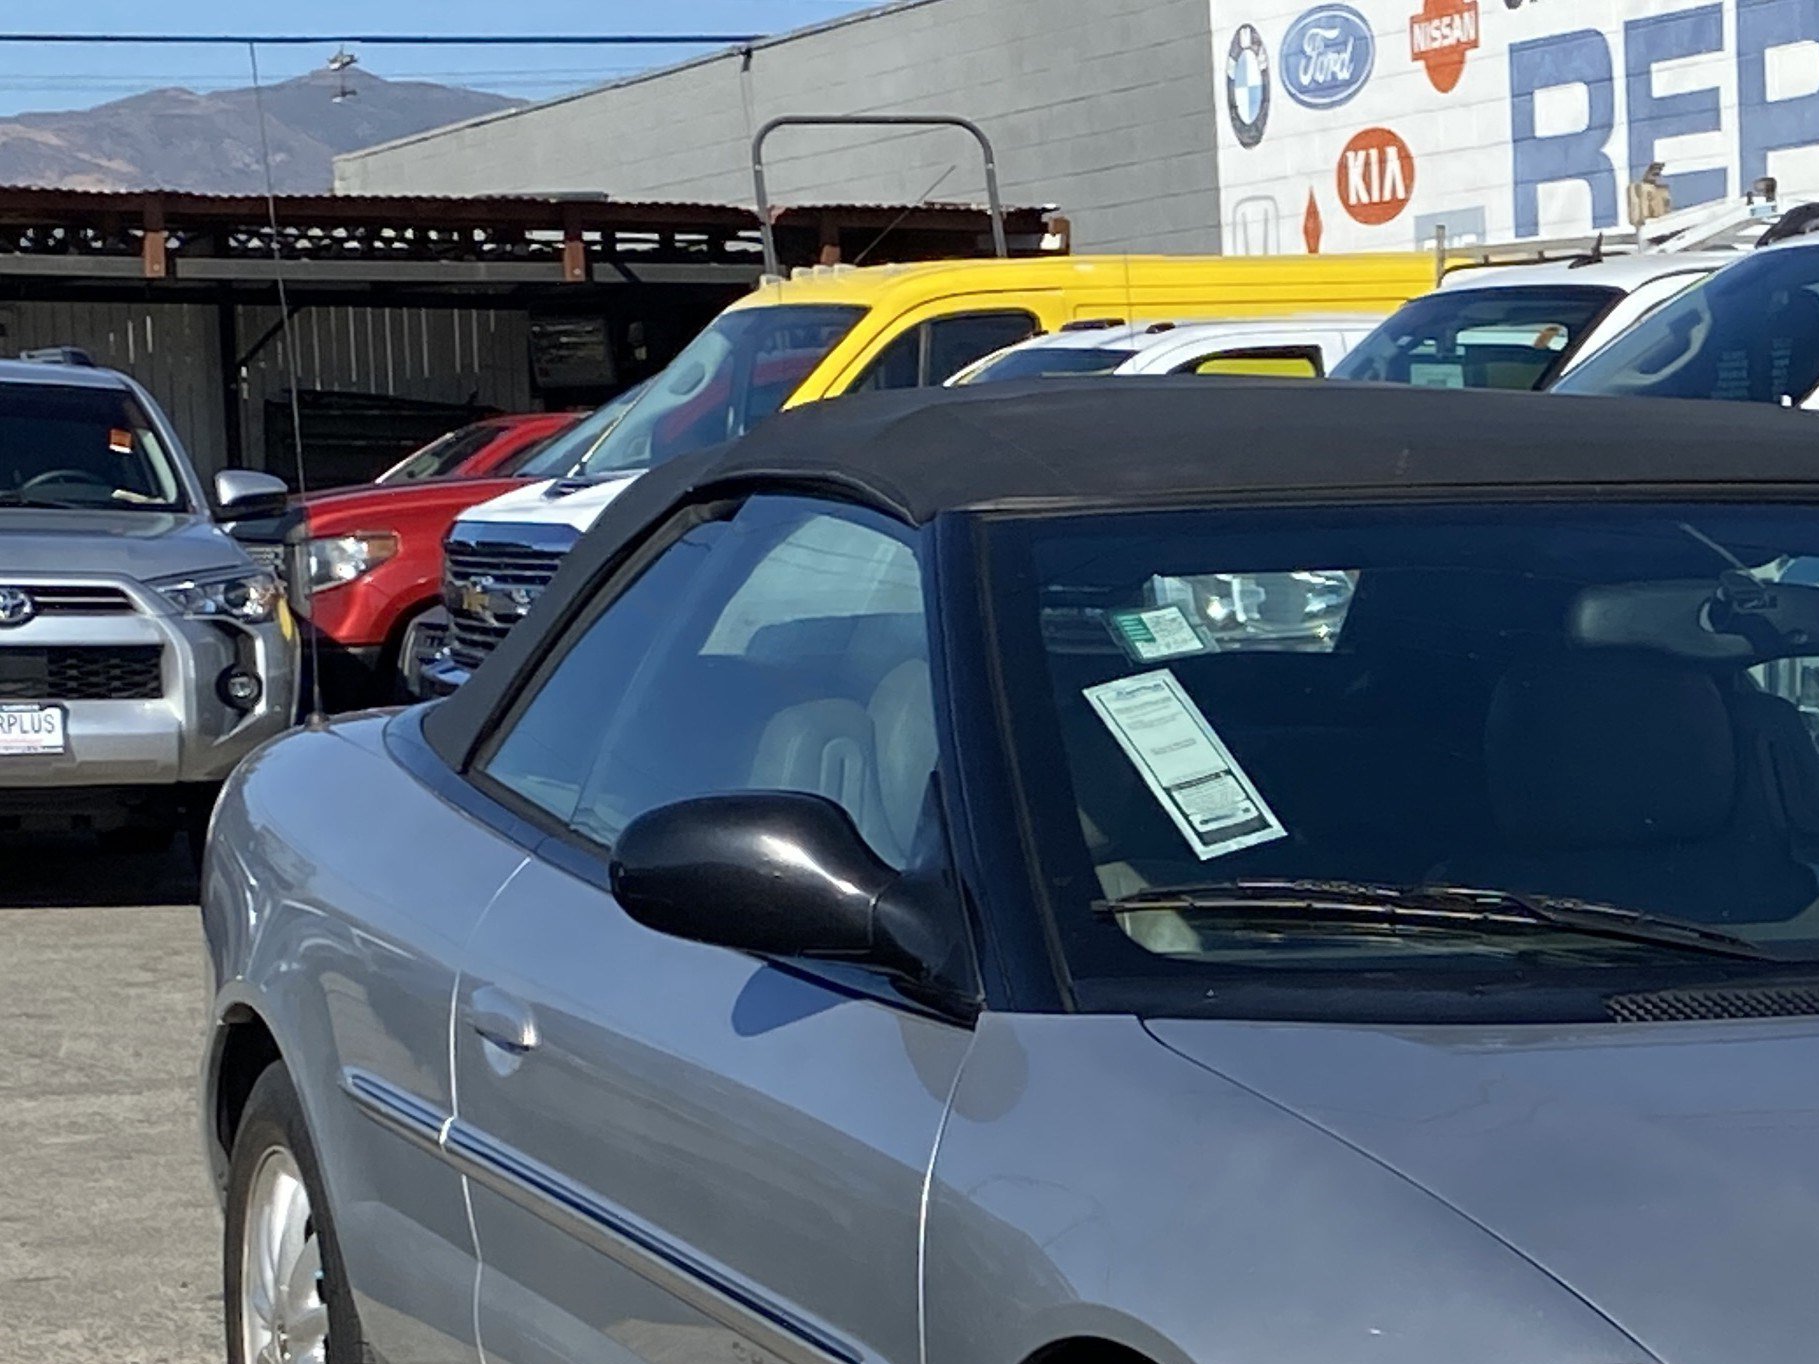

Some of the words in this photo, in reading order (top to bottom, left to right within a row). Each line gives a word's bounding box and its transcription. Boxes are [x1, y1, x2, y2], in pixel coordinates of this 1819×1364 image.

[1300, 27, 1352, 87] Ford
[1412, 10, 1476, 53] NISSAN
[1345, 146, 1406, 204] KIA
